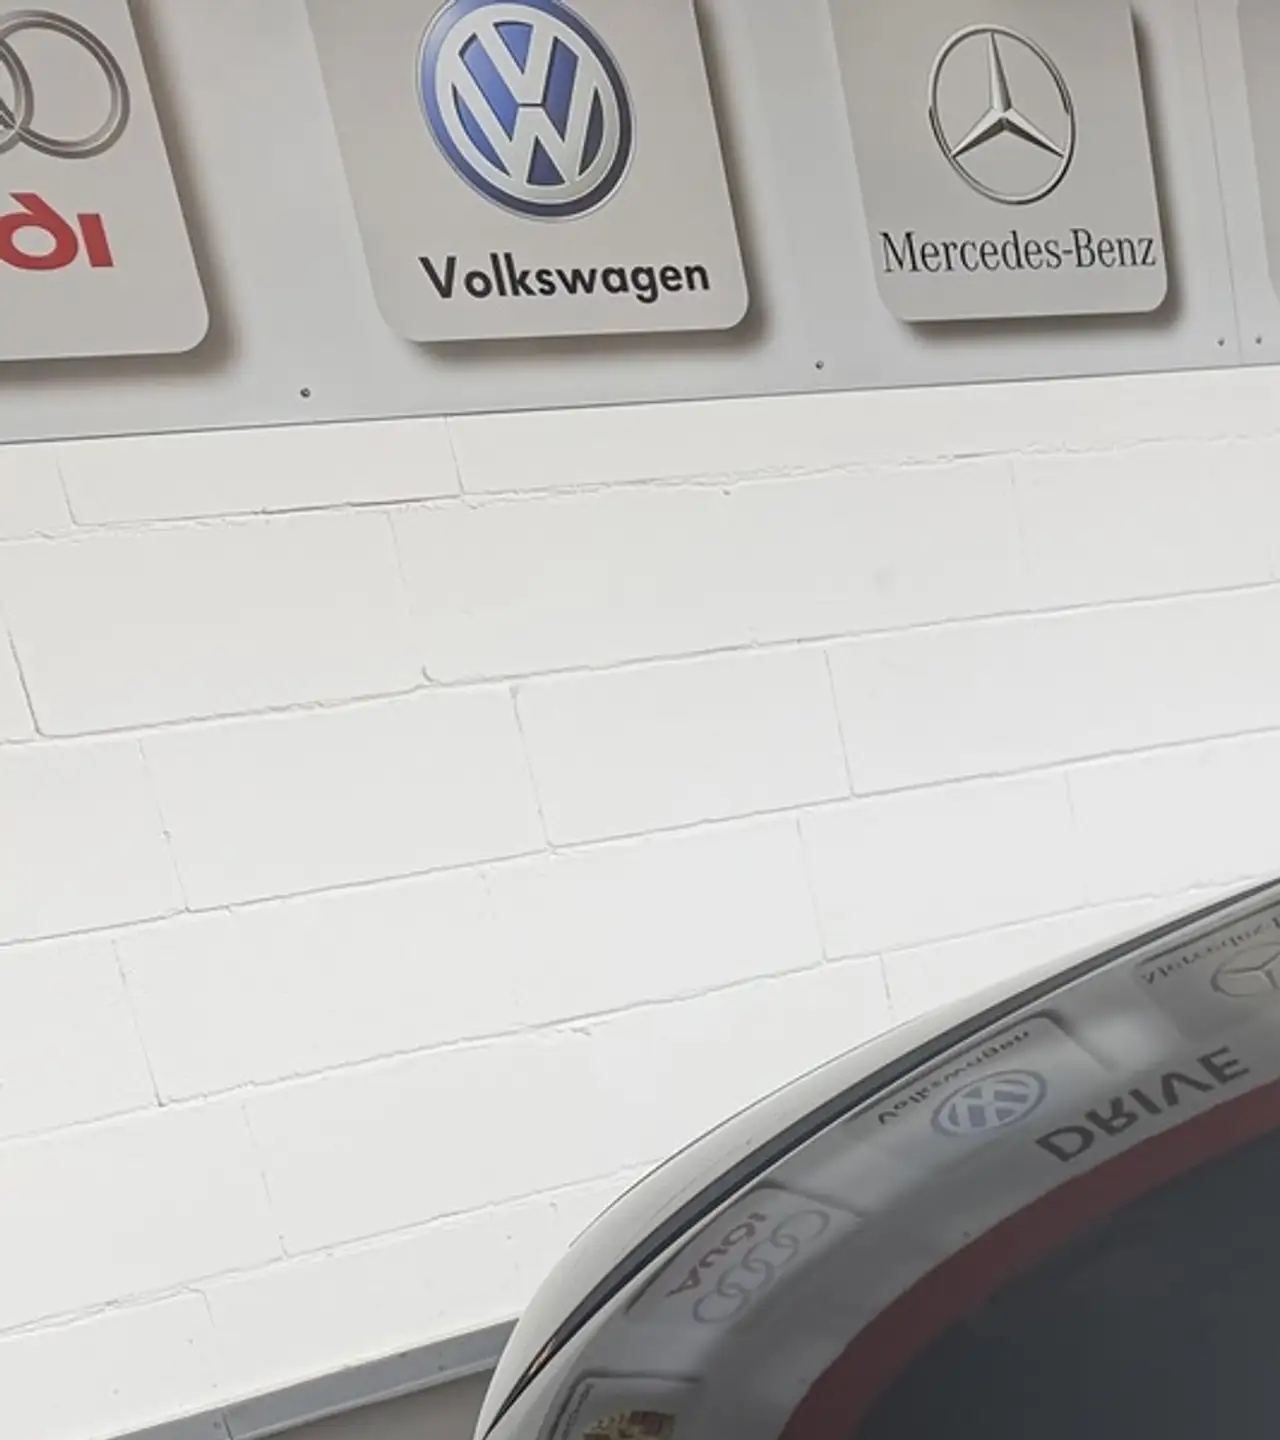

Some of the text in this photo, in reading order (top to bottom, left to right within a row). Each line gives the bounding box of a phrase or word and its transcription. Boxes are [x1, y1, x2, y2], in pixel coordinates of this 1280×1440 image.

[0, 191, 115, 271] di
[880, 227, 1157, 276] Mercedes-Benz
[419, 253, 710, 305] Volkswagen
